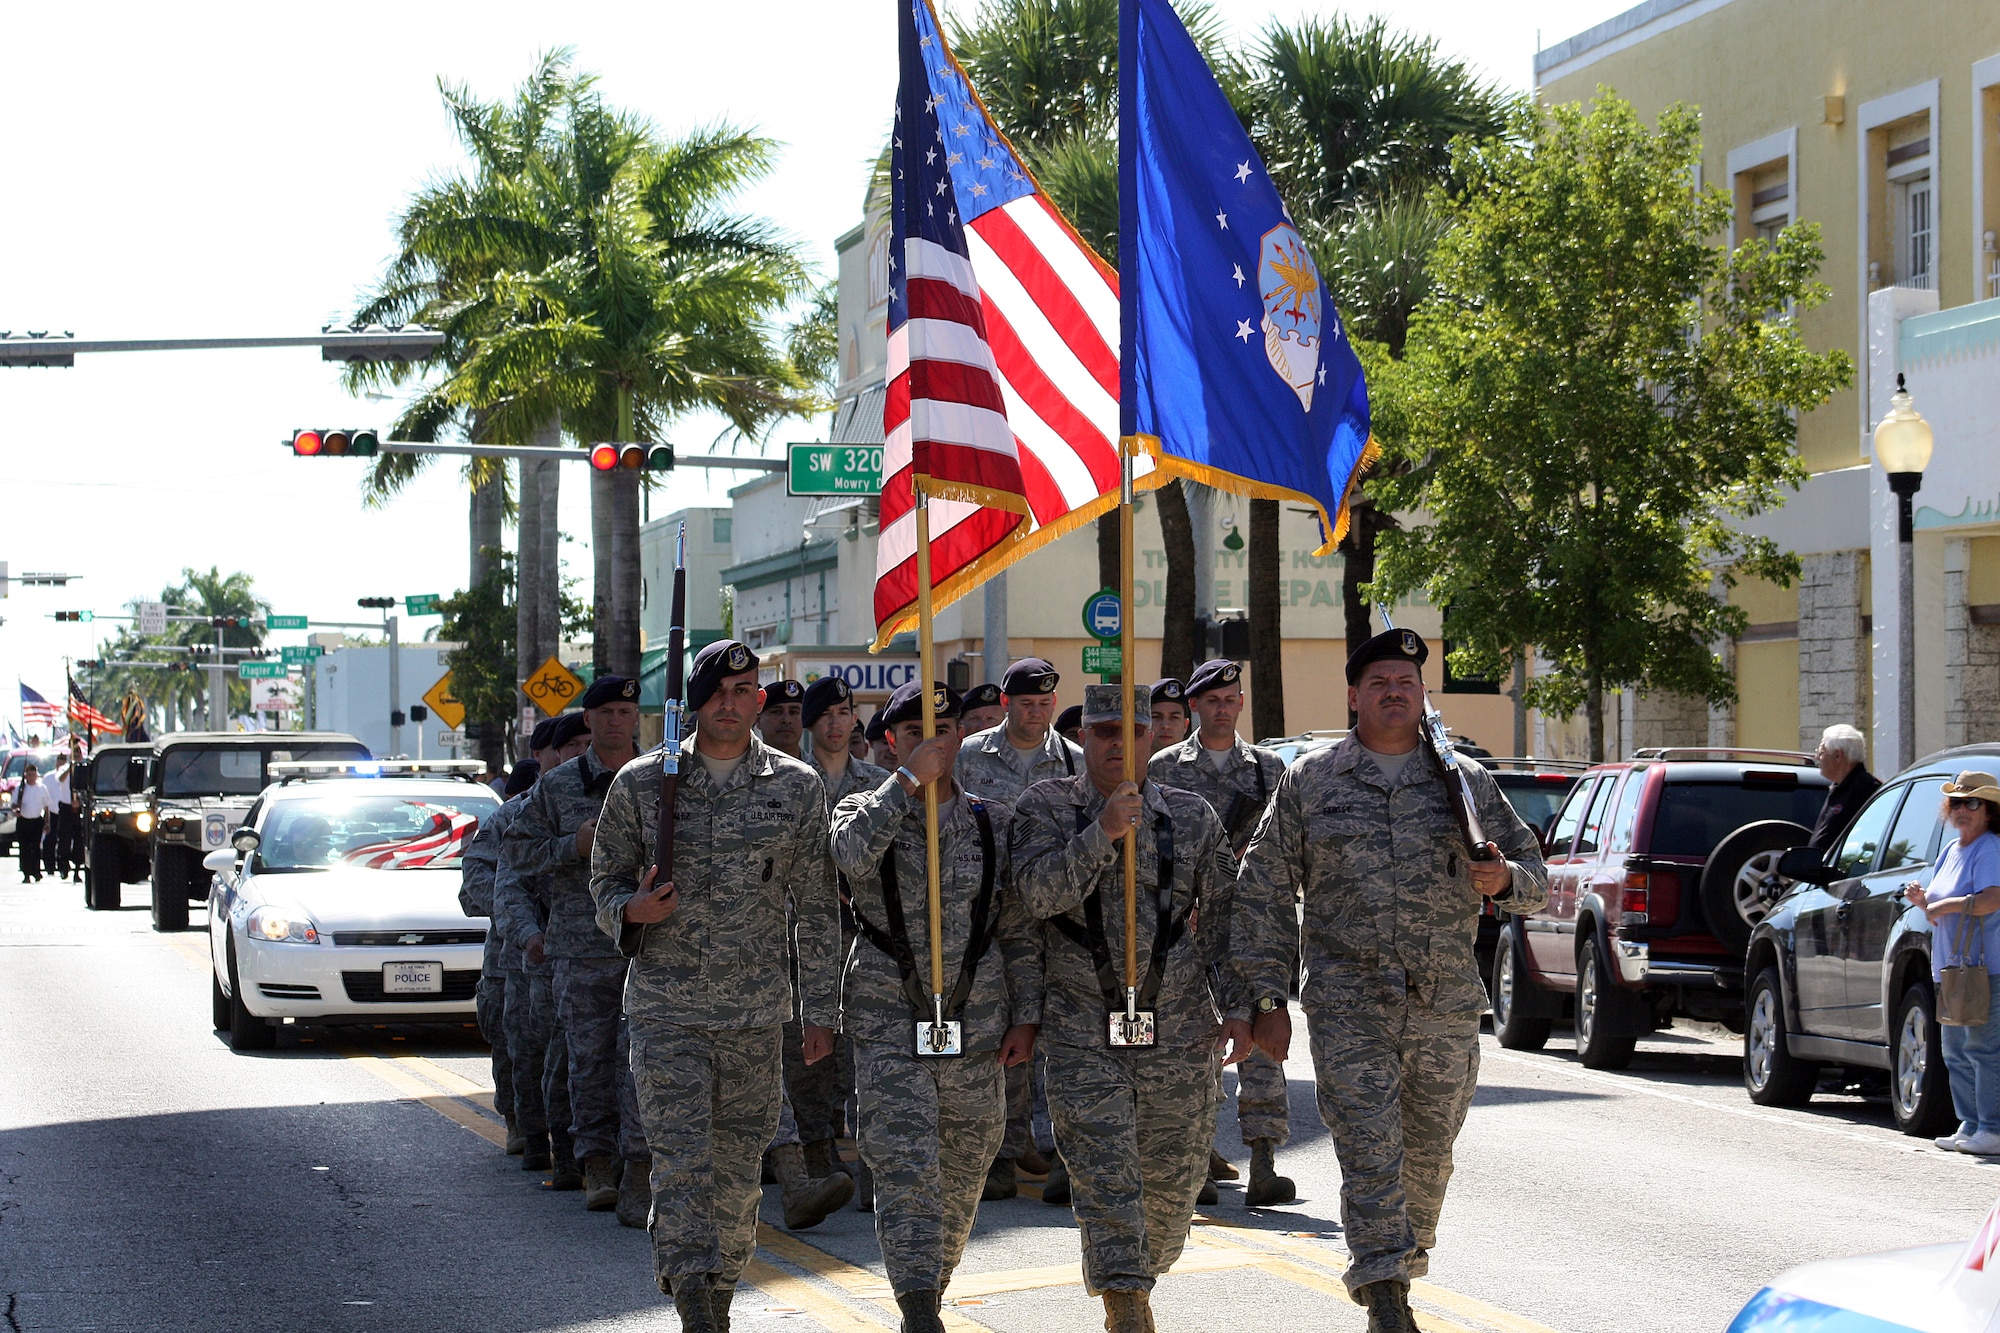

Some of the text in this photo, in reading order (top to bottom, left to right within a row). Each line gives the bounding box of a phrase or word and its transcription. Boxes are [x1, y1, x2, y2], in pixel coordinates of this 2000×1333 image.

[1266, 326, 1292, 380] UNITED
[809, 449, 883, 472] SW 320
[834, 477, 870, 492] Mowry
[273, 618, 300, 627] BUSWAY
[1085, 647, 1100, 658] 344
[1086, 658, 1100, 668] 344
[241, 665, 285, 677] Flagler Av
[440, 734, 462, 743] AHEA
[395, 973, 431, 983] POLICE
